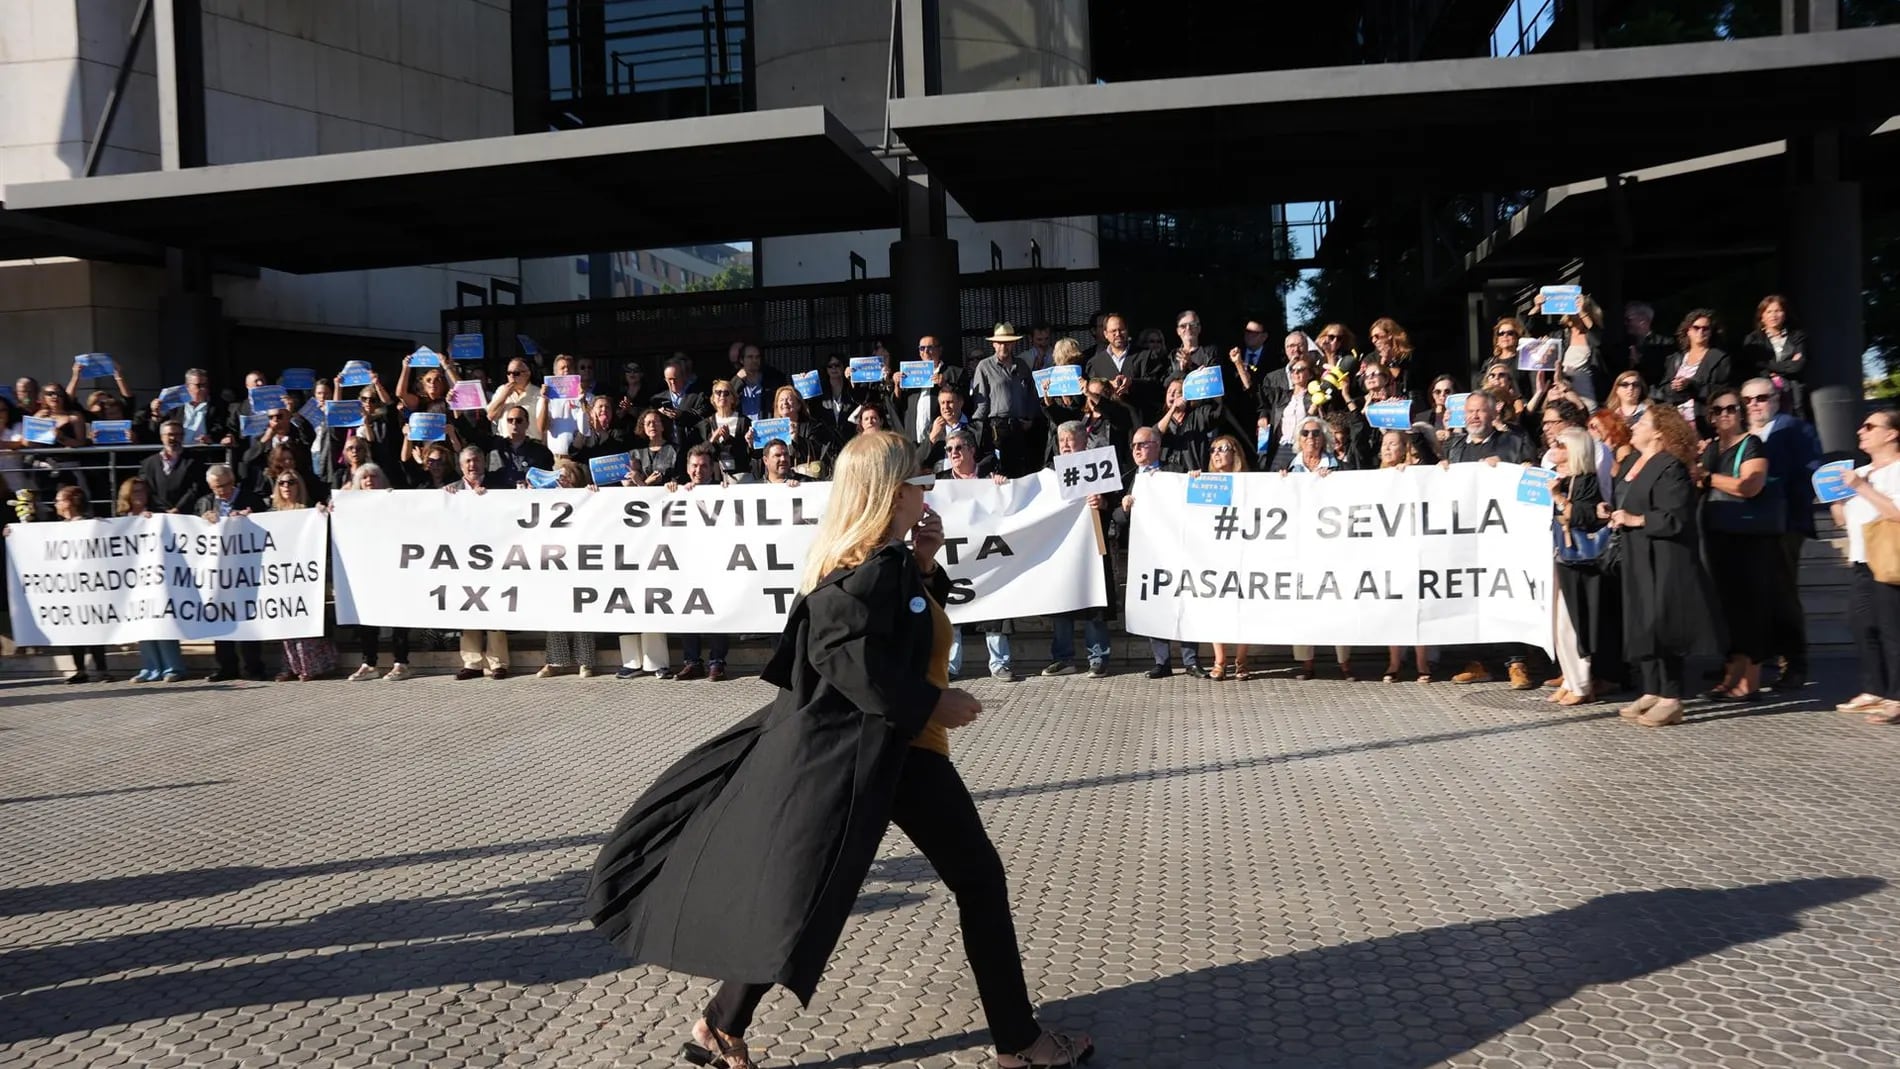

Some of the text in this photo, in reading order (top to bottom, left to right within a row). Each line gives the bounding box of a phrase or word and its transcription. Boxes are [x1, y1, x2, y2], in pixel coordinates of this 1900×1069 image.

[1063, 460, 1115, 487] #J2
[517, 499, 819, 528] J2 SEVILL
[1214, 499, 1508, 541] #J2 SEVILLA
[164, 533, 188, 554] J2
[196, 531, 276, 556] SEVILLA
[400, 535, 1014, 571] PASARELA AL TA
[23, 561, 319, 593] PROCURADORES MUTUALISTAS
[1140, 568, 1342, 601] ¡PASARELA
[1354, 571, 1403, 600] AL
[1419, 568, 1514, 599] RETA
[39, 605, 71, 626] POR
[79, 604, 120, 625] UNA
[245, 596, 309, 620] DIGNA
[429, 585, 714, 614] 1X1 PARA
